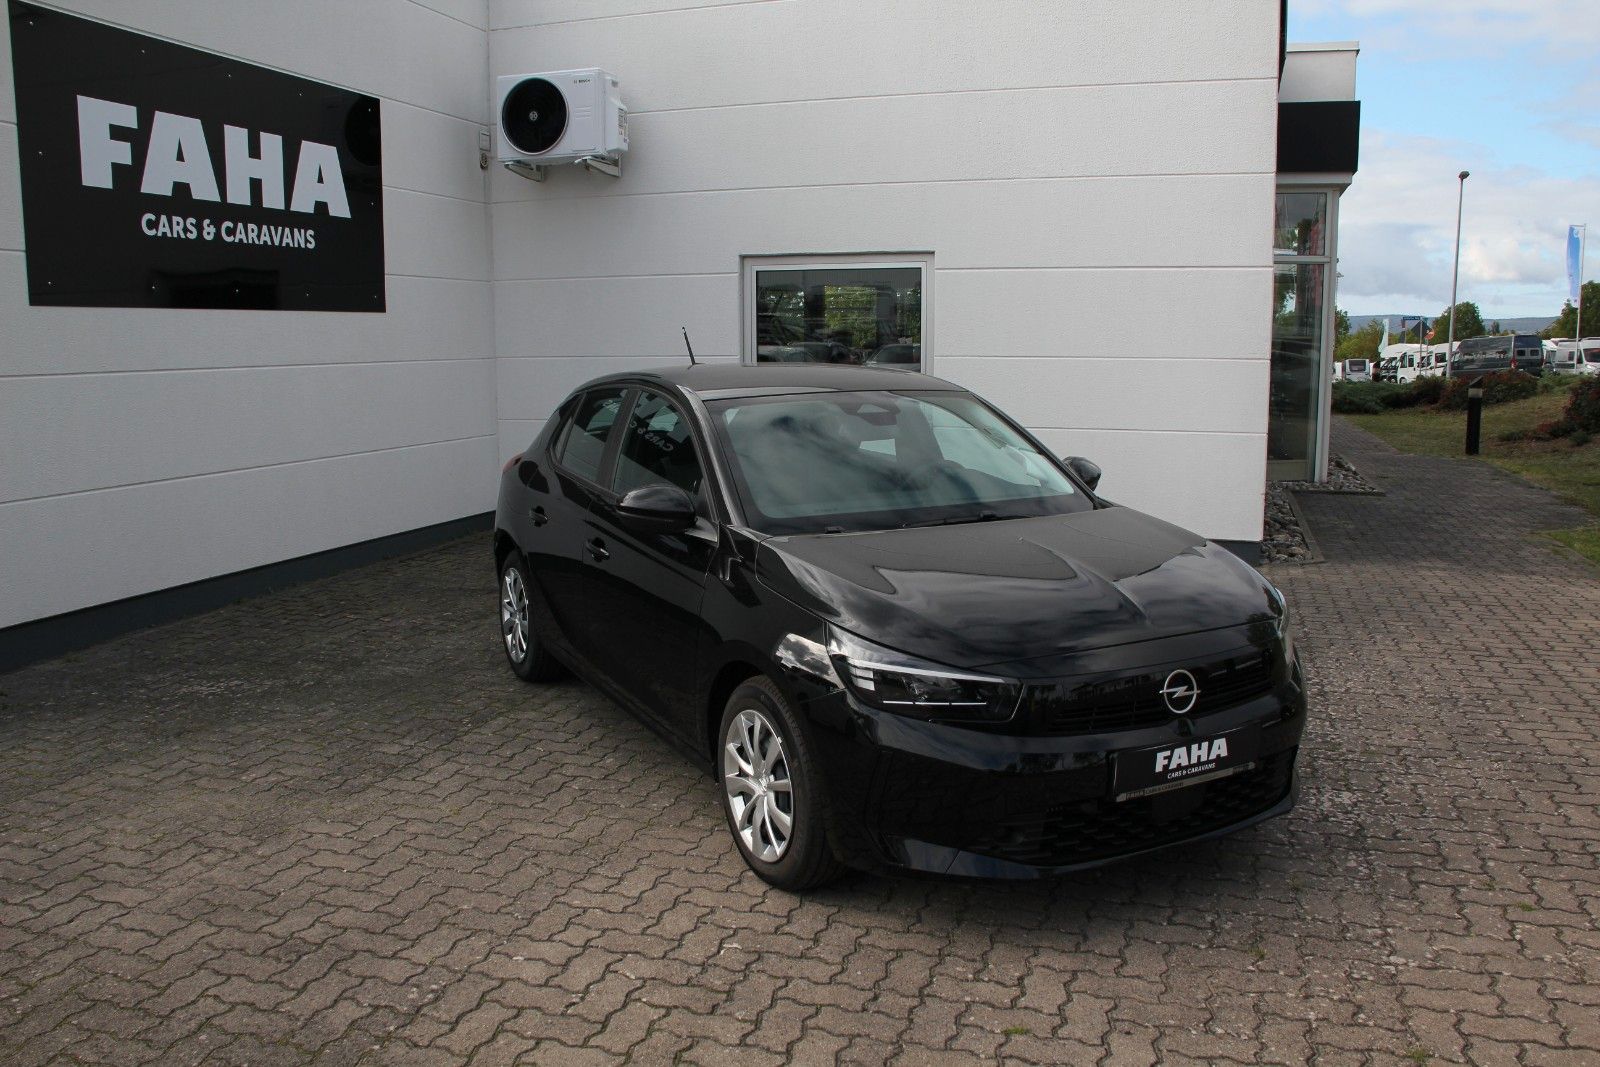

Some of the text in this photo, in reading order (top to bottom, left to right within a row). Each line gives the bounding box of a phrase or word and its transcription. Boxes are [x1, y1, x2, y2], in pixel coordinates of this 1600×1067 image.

[76, 94, 352, 219] FAHA
[141, 212, 316, 249] CARS & CARAVANS
[1155, 737, 1228, 773] FAHA
[1167, 770, 1182, 780] CARS
[1187, 763, 1216, 775] CARAVANS
